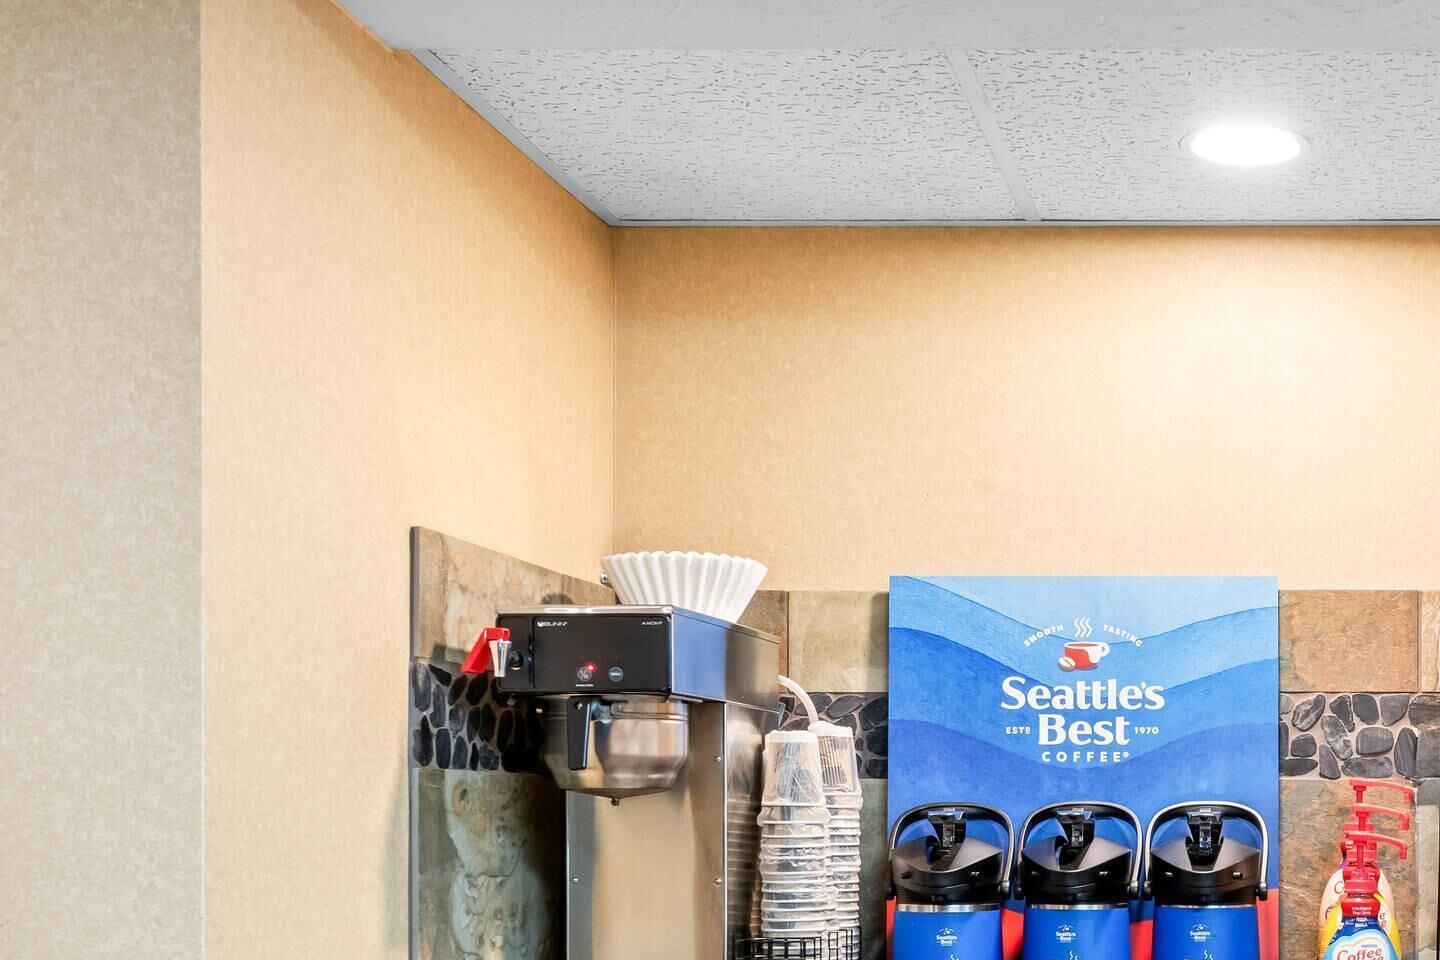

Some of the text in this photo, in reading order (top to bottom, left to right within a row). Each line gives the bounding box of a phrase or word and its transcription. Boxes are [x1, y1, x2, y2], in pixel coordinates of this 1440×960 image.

[1023, 624, 1143, 647] SMOOTH TASTING
[1001, 675, 1166, 710] Seattle's
[1038, 713, 1131, 746] Best
[1134, 726, 1160, 735] 1970
